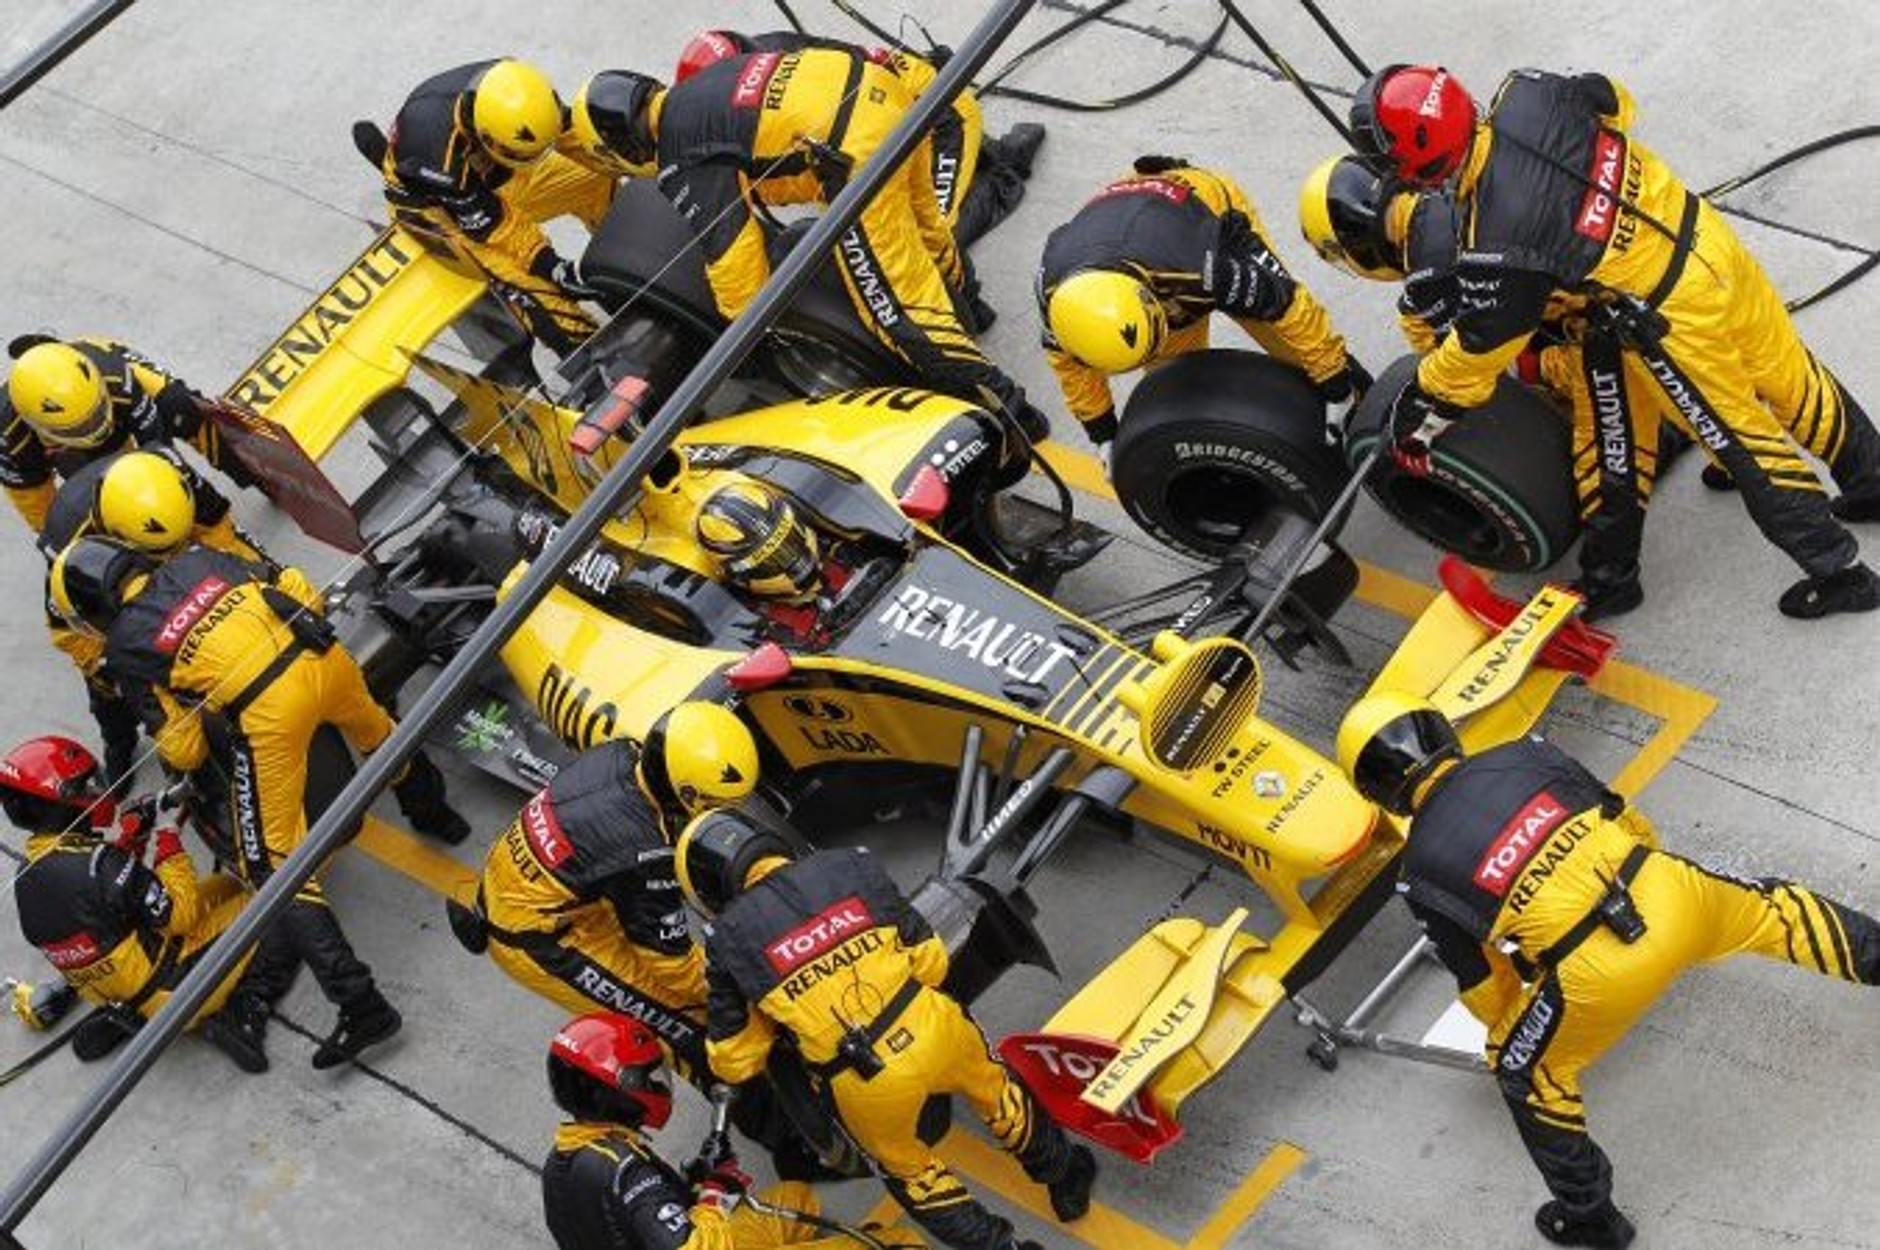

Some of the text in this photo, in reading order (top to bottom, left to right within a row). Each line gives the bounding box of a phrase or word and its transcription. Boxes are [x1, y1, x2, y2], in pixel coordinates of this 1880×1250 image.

[765, 50, 805, 111] RENAUL
[1583, 144, 1620, 226] TOTAL
[843, 226, 899, 328] RENAUL
[228, 230, 411, 413] RENAULT
[1592, 369, 1628, 475] RENAULT
[1644, 356, 1731, 450] RENAULT
[160, 581, 225, 640] TOTAL
[179, 590, 247, 665] RENAULT
[878, 585, 1076, 684] RENAULT
[1457, 593, 1555, 702] RENAULT
[799, 726, 892, 754] LADA
[1266, 769, 1325, 834] RENAULT
[1481, 806, 1559, 879] TOTAL
[1510, 820, 1592, 915] RENAULT
[773, 909, 865, 961] TOTAL
[782, 931, 884, 1002] RENAULT
[576, 965, 694, 1040] RENAULT
[1501, 992, 1553, 1070] RENAULT
[1092, 996, 1196, 1099] RENAULT
